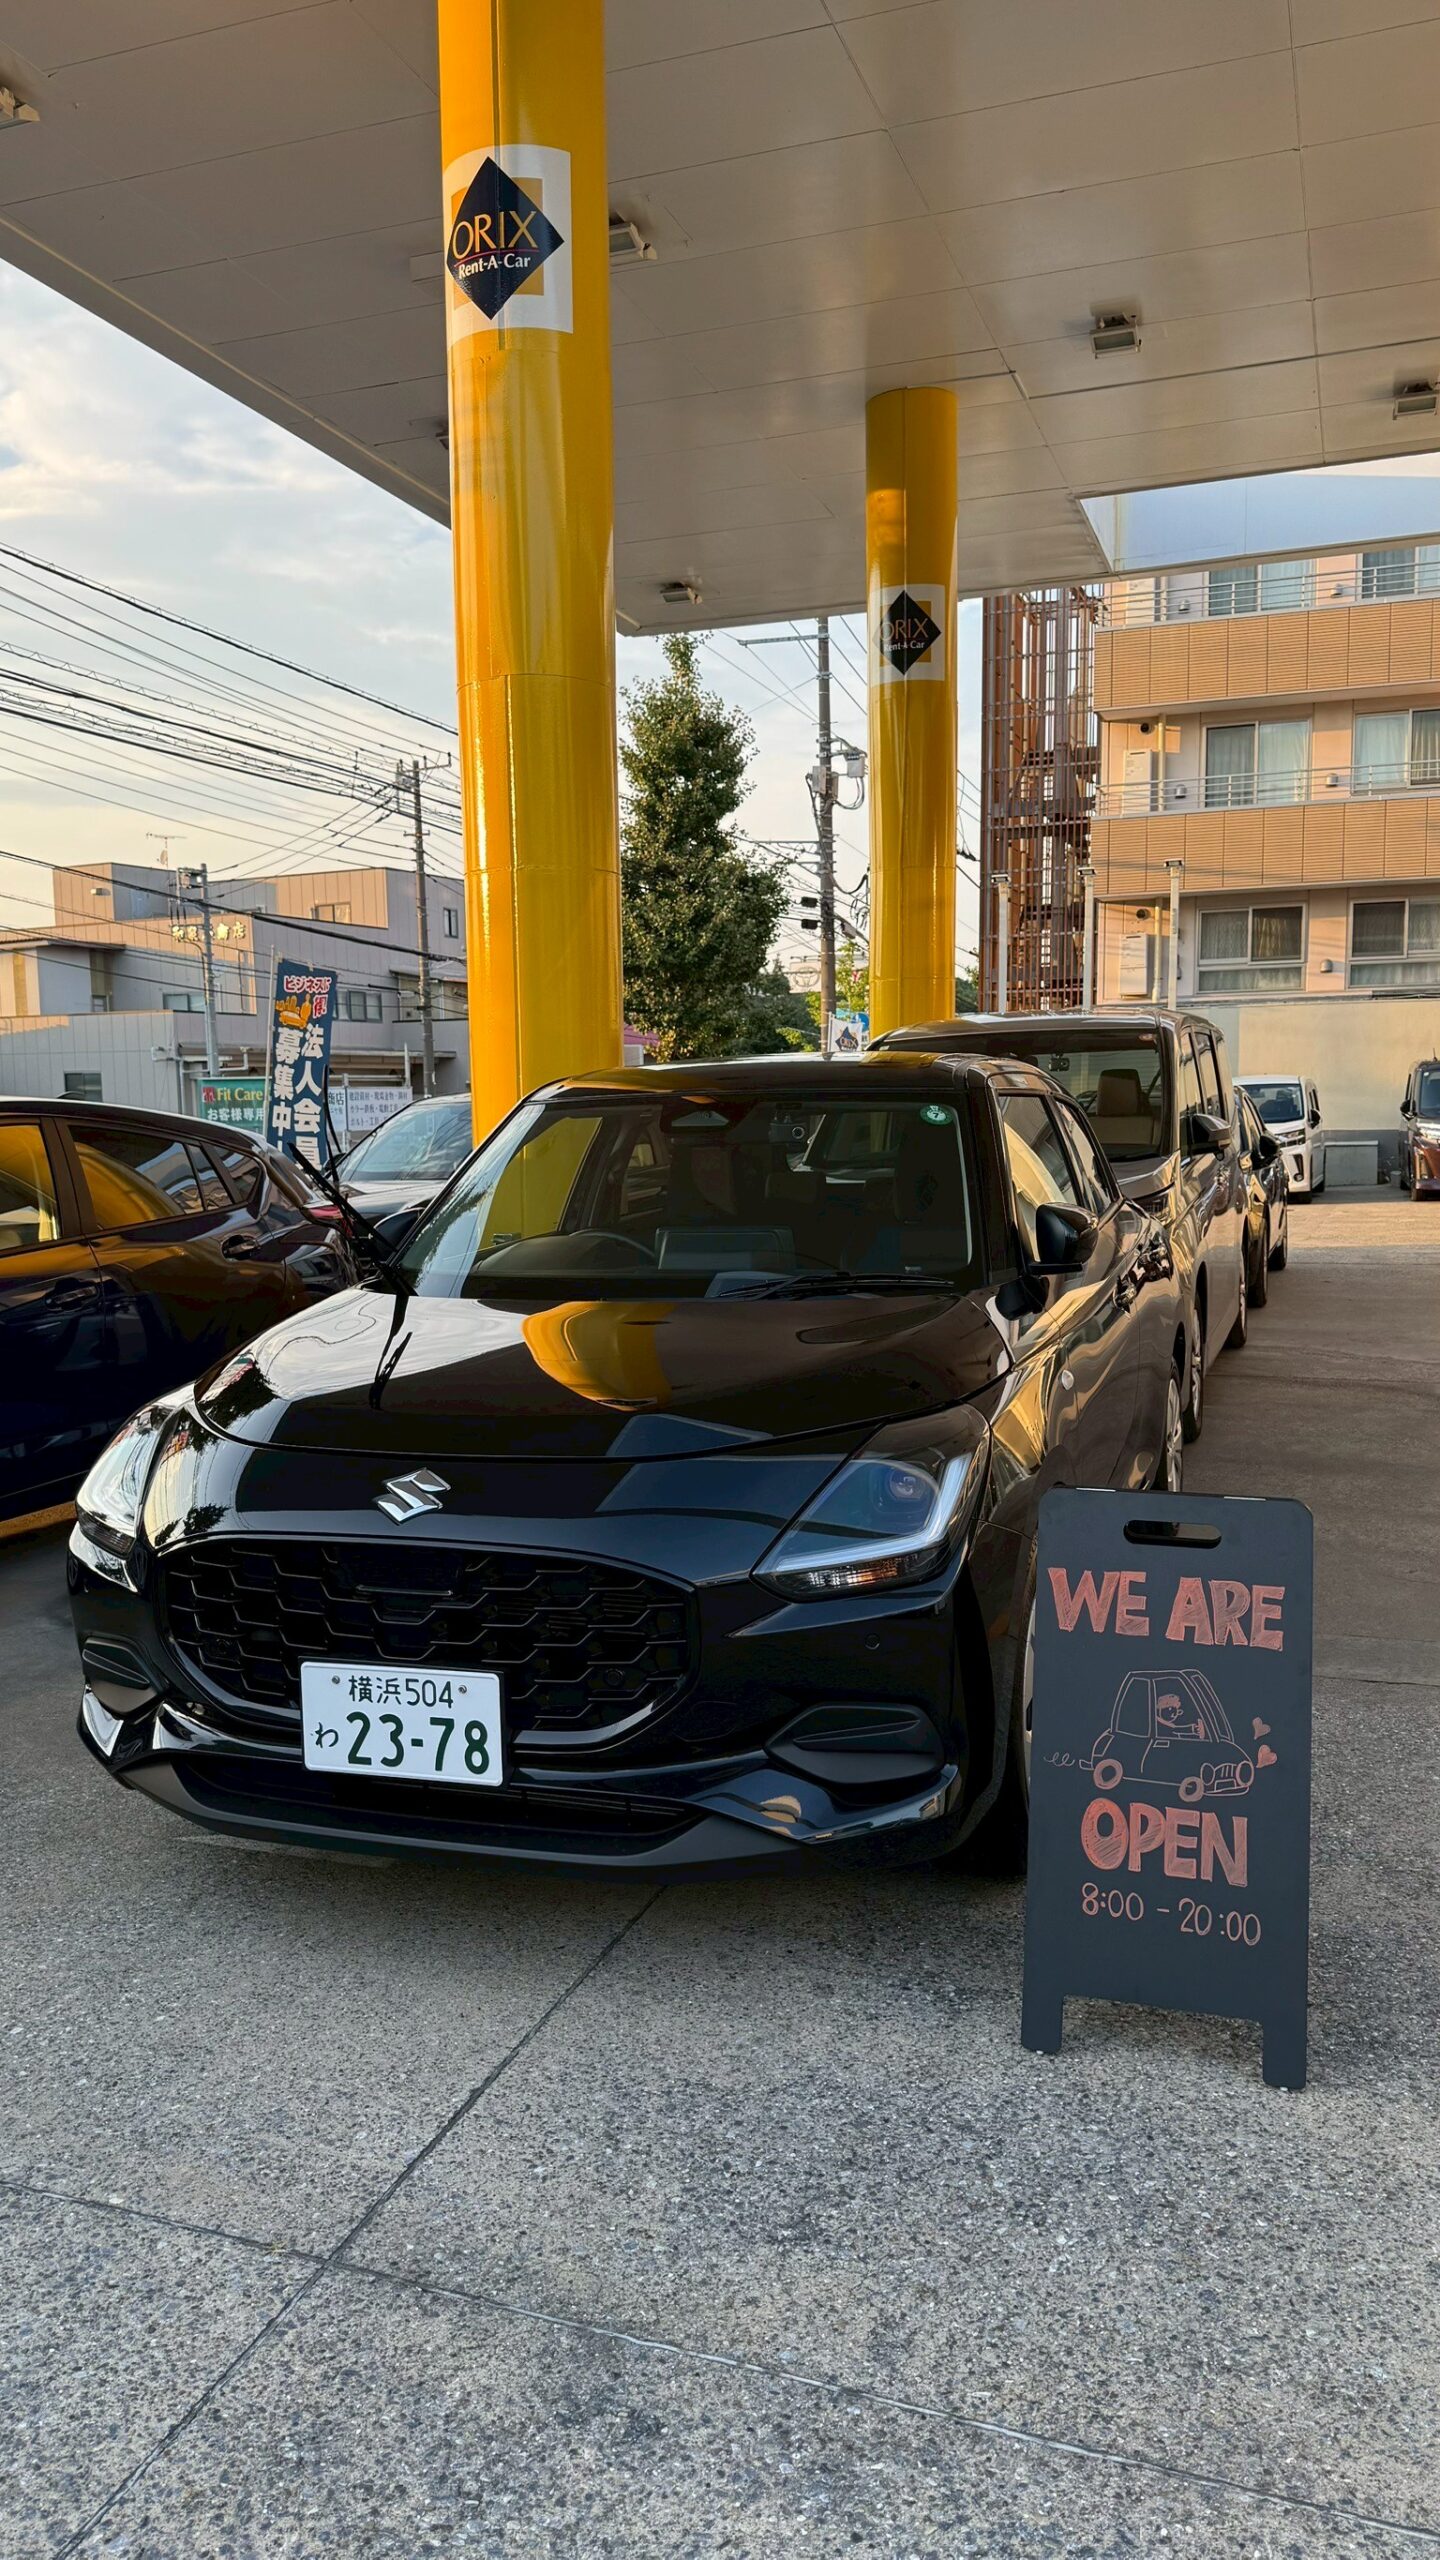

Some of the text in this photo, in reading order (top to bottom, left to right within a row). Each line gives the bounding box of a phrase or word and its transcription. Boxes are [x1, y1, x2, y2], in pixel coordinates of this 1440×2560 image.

[452, 211, 538, 259] ORIX
[458, 253, 531, 279] Rent-A-Car
[881, 618, 928, 640] ORIX
[217, 1087, 263, 1101] Fit Care
[1047, 1567, 1285, 1651] WE ARE
[312, 1711, 490, 1775] わ 23-78
[1081, 1798, 1248, 1888] OPEN
[1081, 1882, 1144, 1921] 8:00
